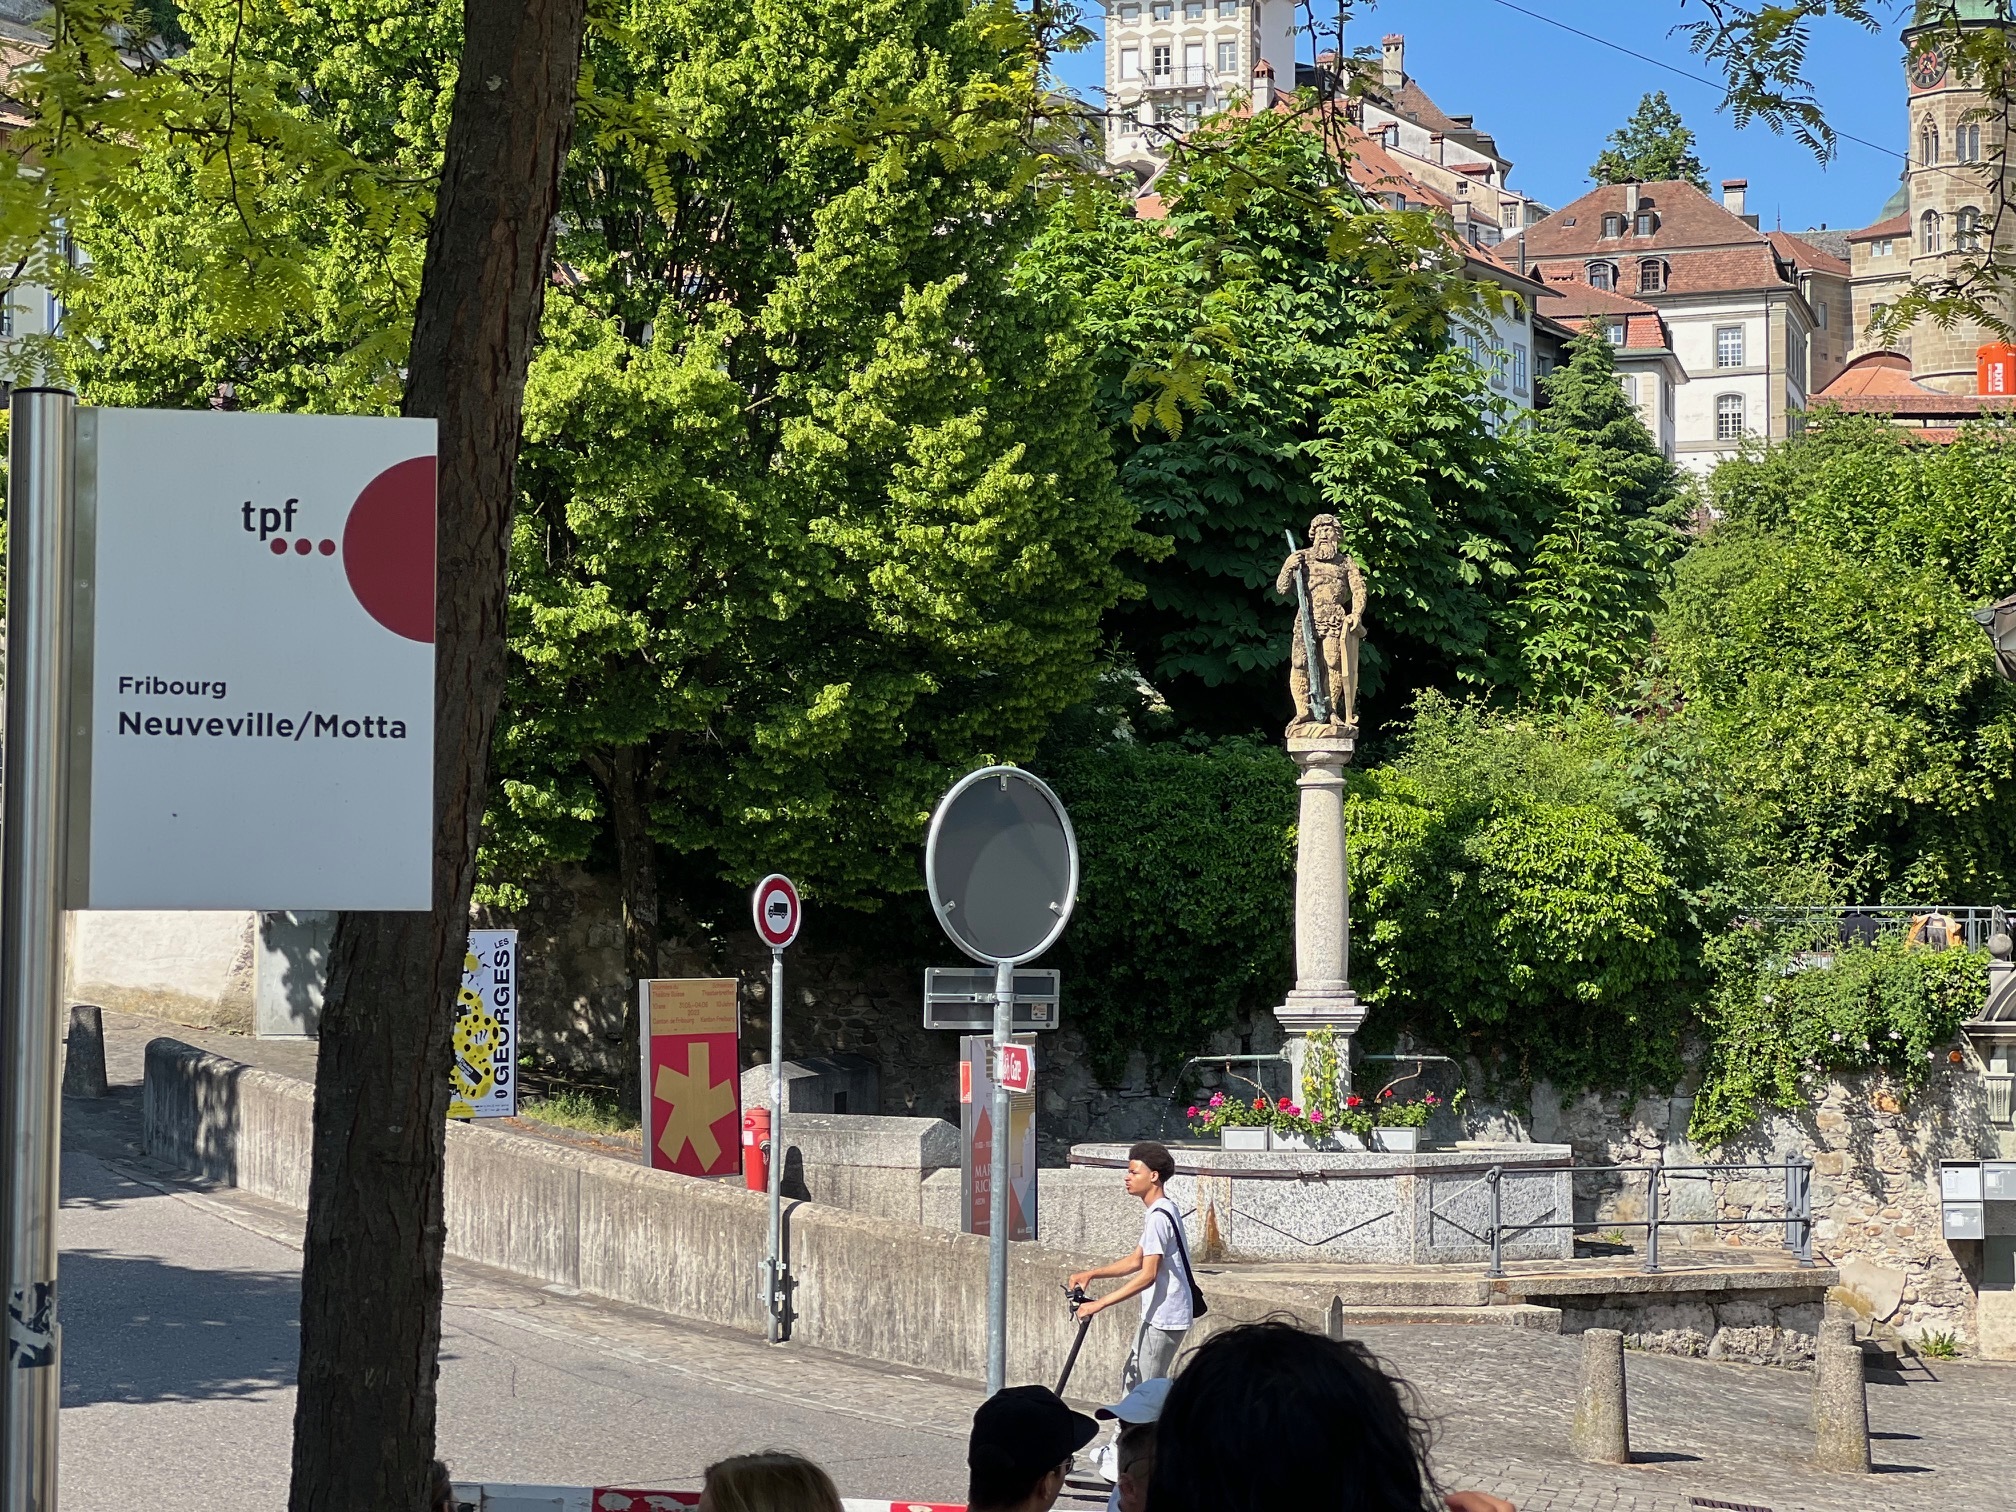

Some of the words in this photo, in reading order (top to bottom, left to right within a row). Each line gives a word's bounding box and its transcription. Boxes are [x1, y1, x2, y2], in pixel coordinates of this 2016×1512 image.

[241, 498, 299, 541] tpf
[118, 676, 227, 699] Fribourg
[118, 711, 407, 741] Neuveville/Motta
[494, 938, 510, 949] LES
[493, 949, 510, 1086] GEORGES
[1010, 1052, 1022, 1082] Gare
